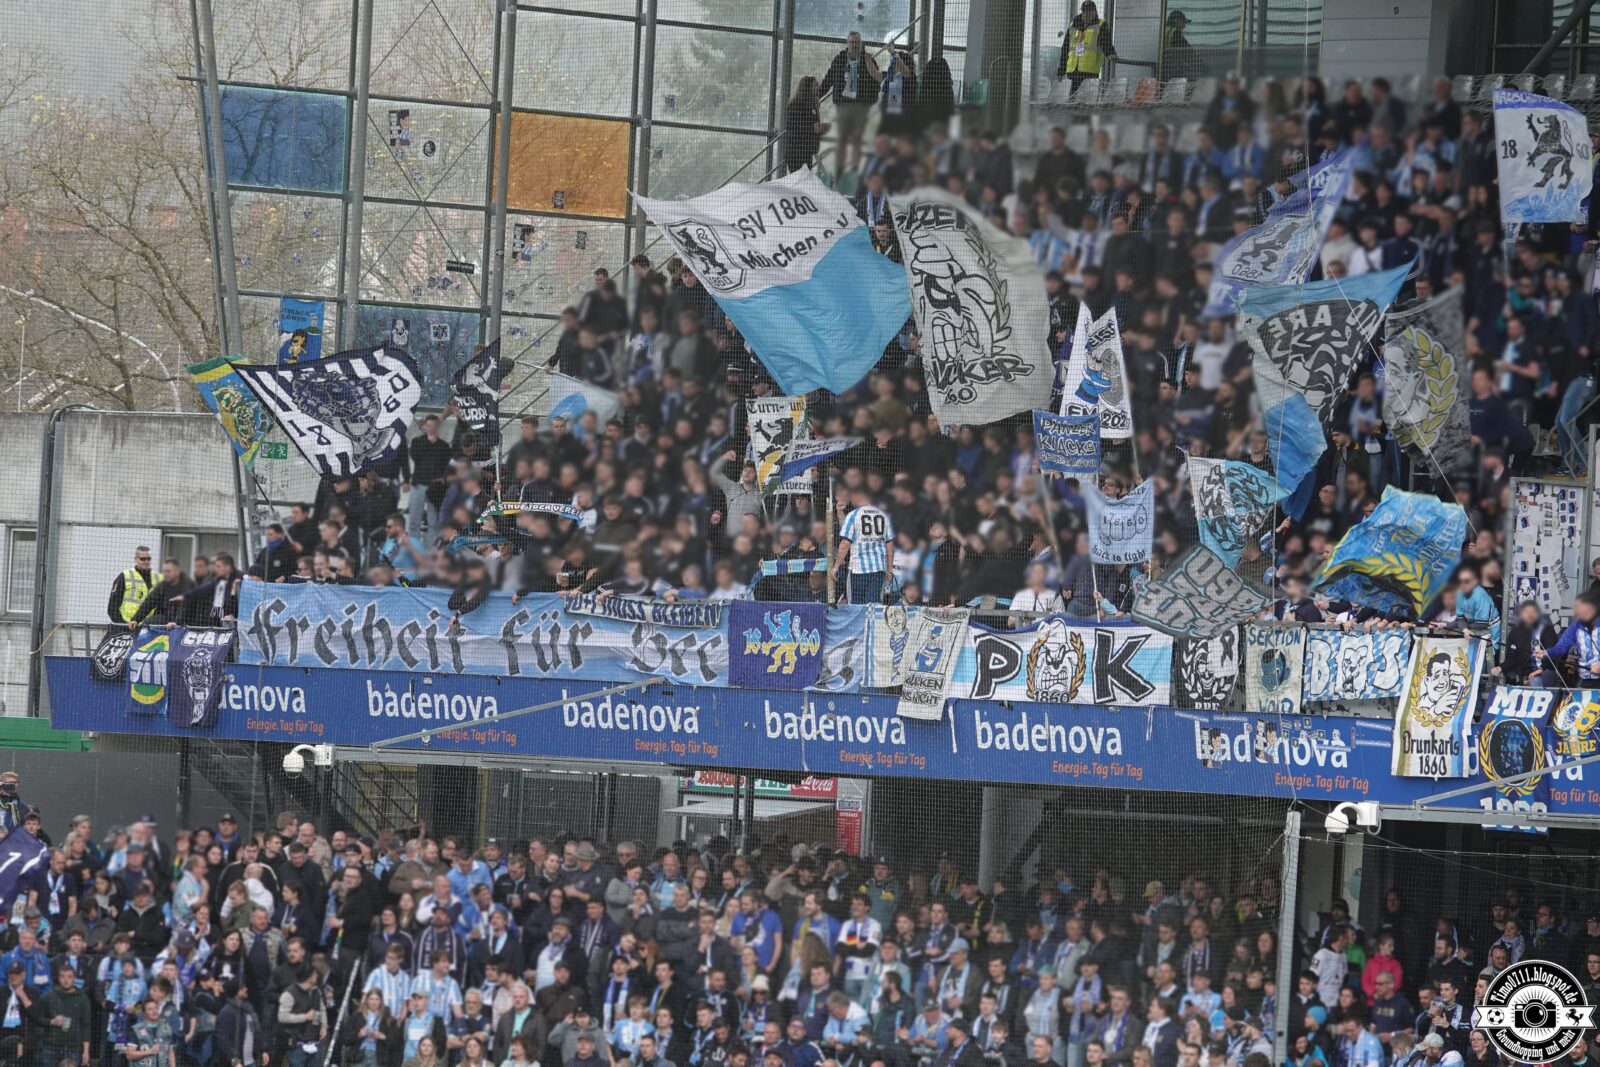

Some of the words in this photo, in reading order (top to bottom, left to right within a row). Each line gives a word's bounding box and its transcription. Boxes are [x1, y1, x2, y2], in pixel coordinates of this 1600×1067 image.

[1502, 139, 1518, 159] 18
[767, 195, 819, 227] 1860
[861, 515, 885, 536] 60
[499, 608, 594, 675] für
[743, 627, 762, 656] 18
[799, 628, 821, 657] 60
[970, 632, 1023, 700] P
[1092, 628, 1156, 704] K
[218, 683, 306, 713] enova
[367, 680, 499, 722] badenova
[1035, 689, 1070, 703] 1860
[1488, 685, 1553, 718] MIB
[562, 688, 700, 733] badenova
[764, 699, 906, 744] badenova
[280, 719, 294, 734] Tag
[295, 719, 307, 731] für
[308, 720, 324, 736] Tag
[471, 729, 486, 744] Tag
[487, 730, 501, 742] für
[502, 731, 517, 746] Tag
[974, 710, 1122, 755] badenova
[670, 739, 686, 756] Tag
[687, 740, 701, 754] für
[703, 741, 719, 758] Tag
[1403, 730, 1459, 756] Drunkarts
[1556, 739, 1597, 754] JAHRE
[876, 751, 893, 767] Tag
[894, 751, 908, 765] für
[909, 753, 926, 769] Tag
[1053, 760, 1092, 777] Energie.
[1092, 762, 1109, 779] Tag
[1110, 762, 1125, 776] für
[1126, 764, 1143, 781] Tag
[1418, 755, 1447, 776] 1860
[1275, 772, 1314, 790] Energie.
[1315, 774, 1333, 792] Tag
[1335, 775, 1350, 789] für
[1351, 776, 1369, 794] Tag
[1550, 788, 1567, 804] Tag
[1570, 788, 1585, 802] für
[1587, 790, 1600, 805] Ta
